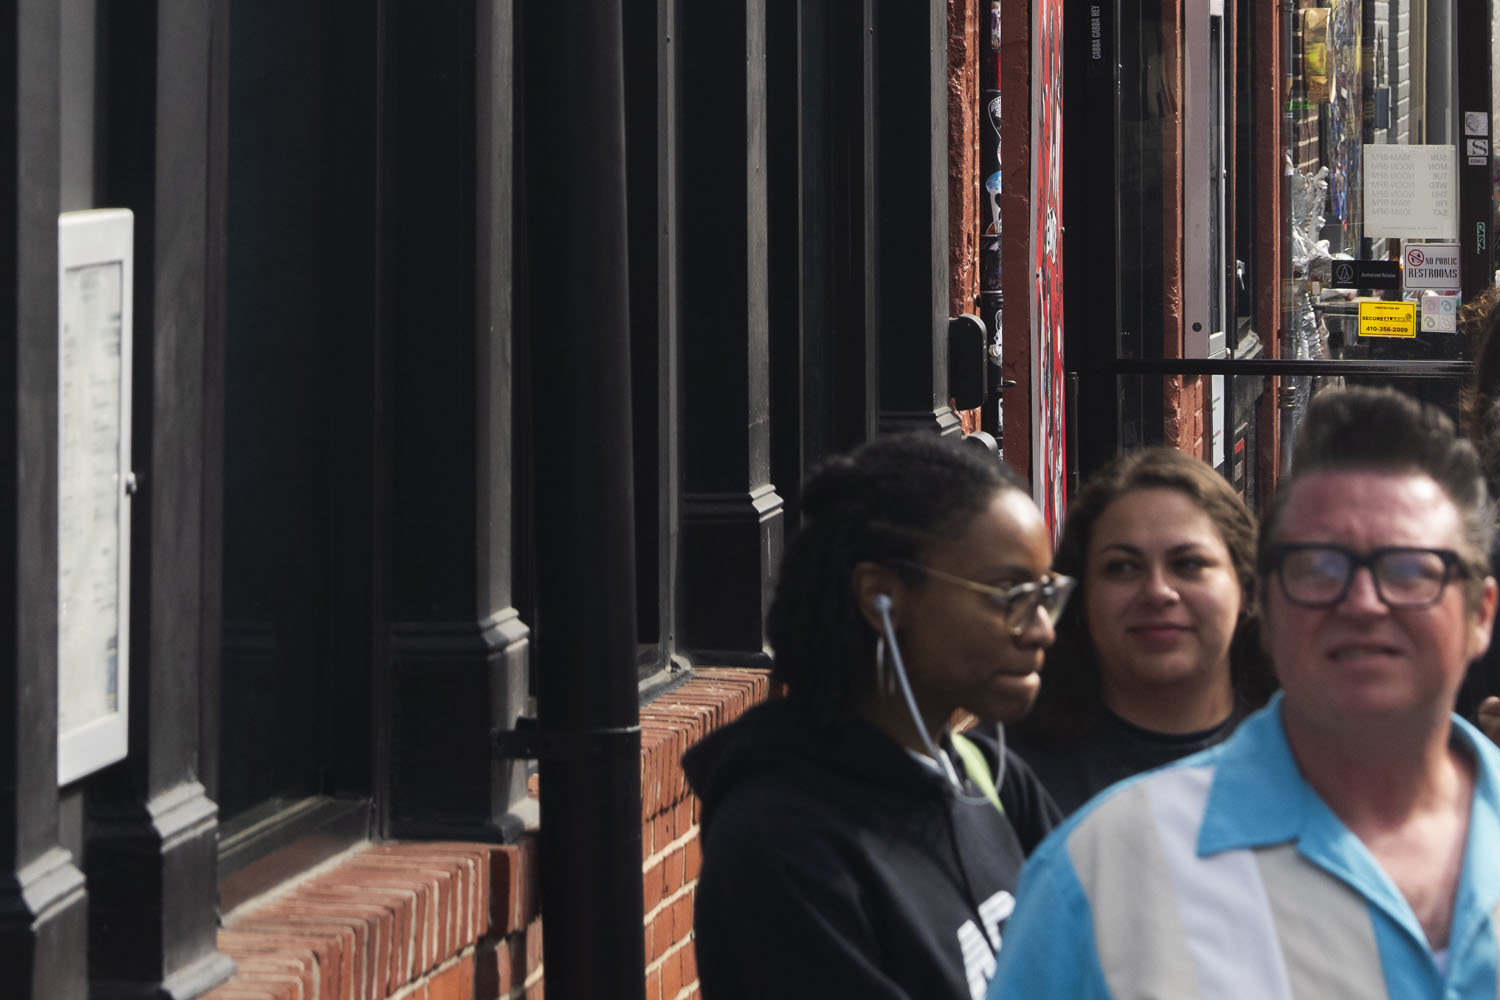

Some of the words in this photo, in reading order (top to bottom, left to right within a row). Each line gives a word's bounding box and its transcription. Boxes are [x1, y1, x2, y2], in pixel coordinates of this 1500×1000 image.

[1091, 5, 1100, 17] HEY
[1425, 257, 1434, 266] NO
[1435, 256, 1458, 266] PUBLIC
[1408, 268, 1458, 279] RESTROOMS
